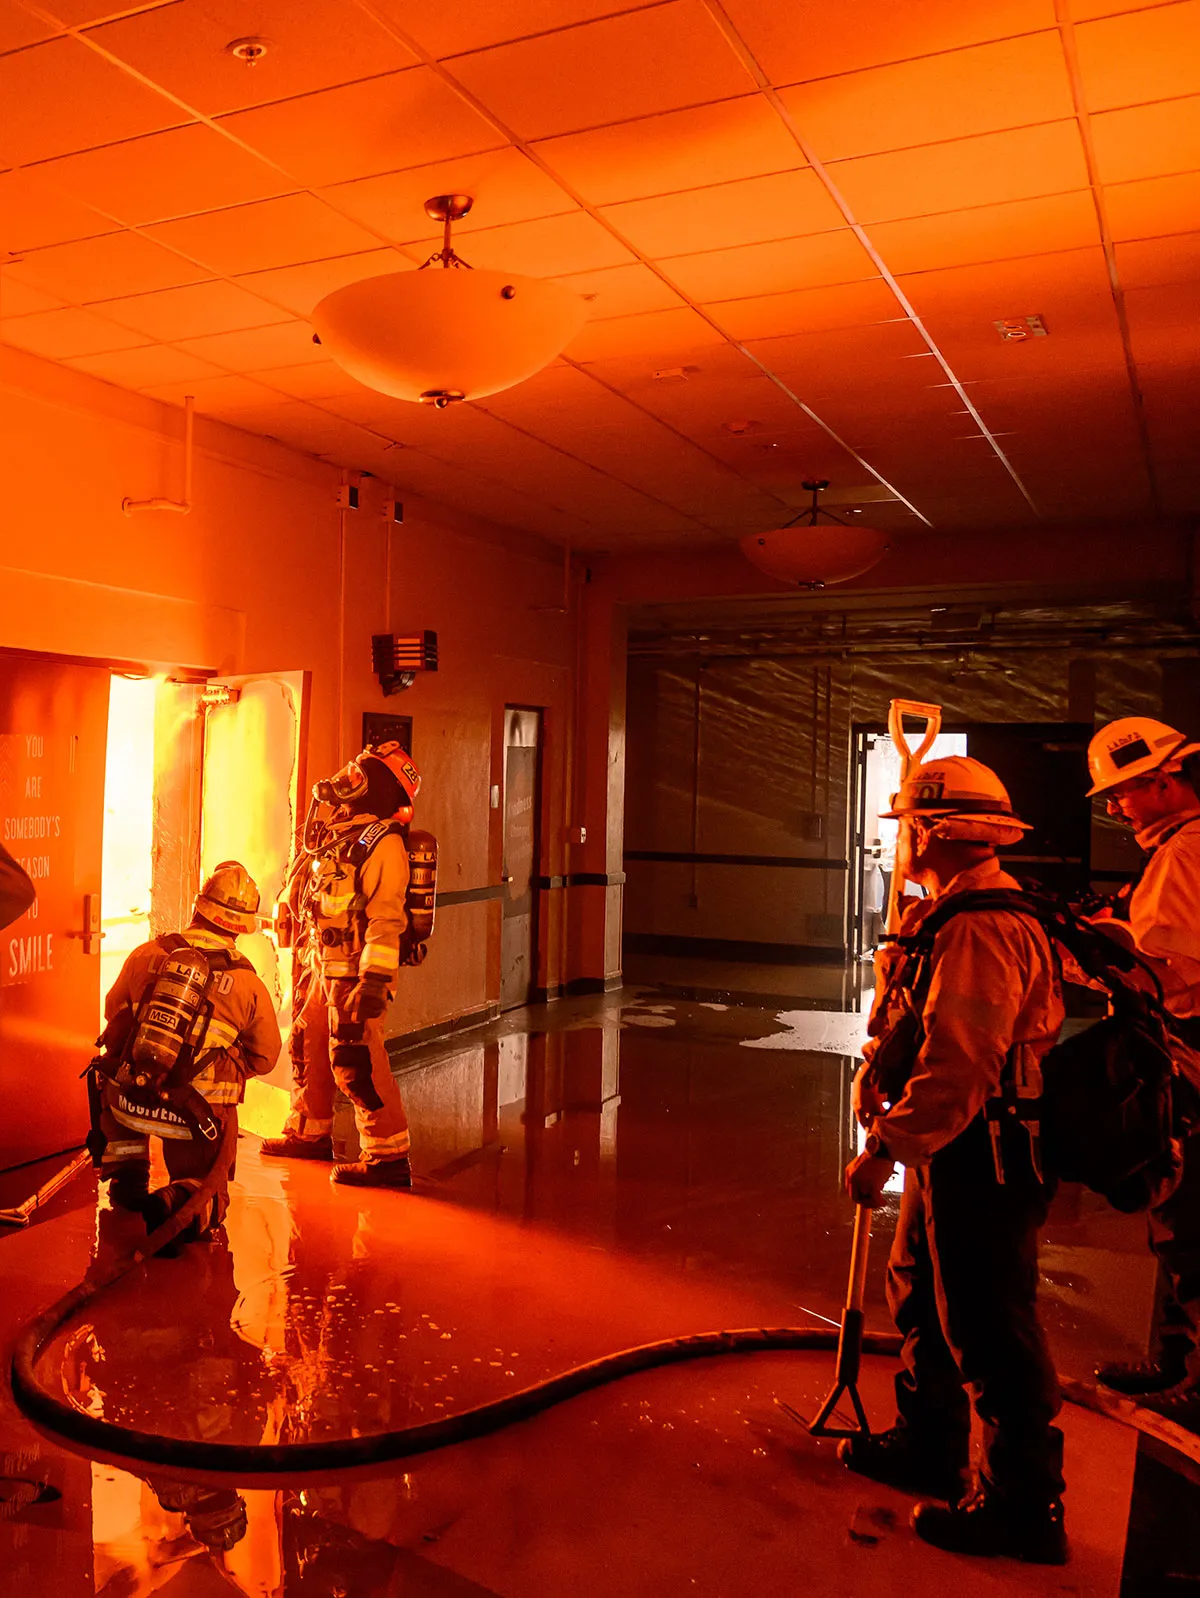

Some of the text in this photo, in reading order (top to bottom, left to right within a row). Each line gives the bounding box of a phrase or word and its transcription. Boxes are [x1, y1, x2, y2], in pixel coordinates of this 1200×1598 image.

[26, 735, 44, 758] YOU
[405, 763, 417, 782] 28
[25, 776, 42, 798] ARE
[4, 816, 60, 840] SOMEBODY'S
[363, 823, 387, 845] MSA
[15, 856, 50, 879] ASON
[9, 933, 53, 977] SMILE
[176, 965, 201, 981] LAC
[150, 1010, 177, 1027] MSA
